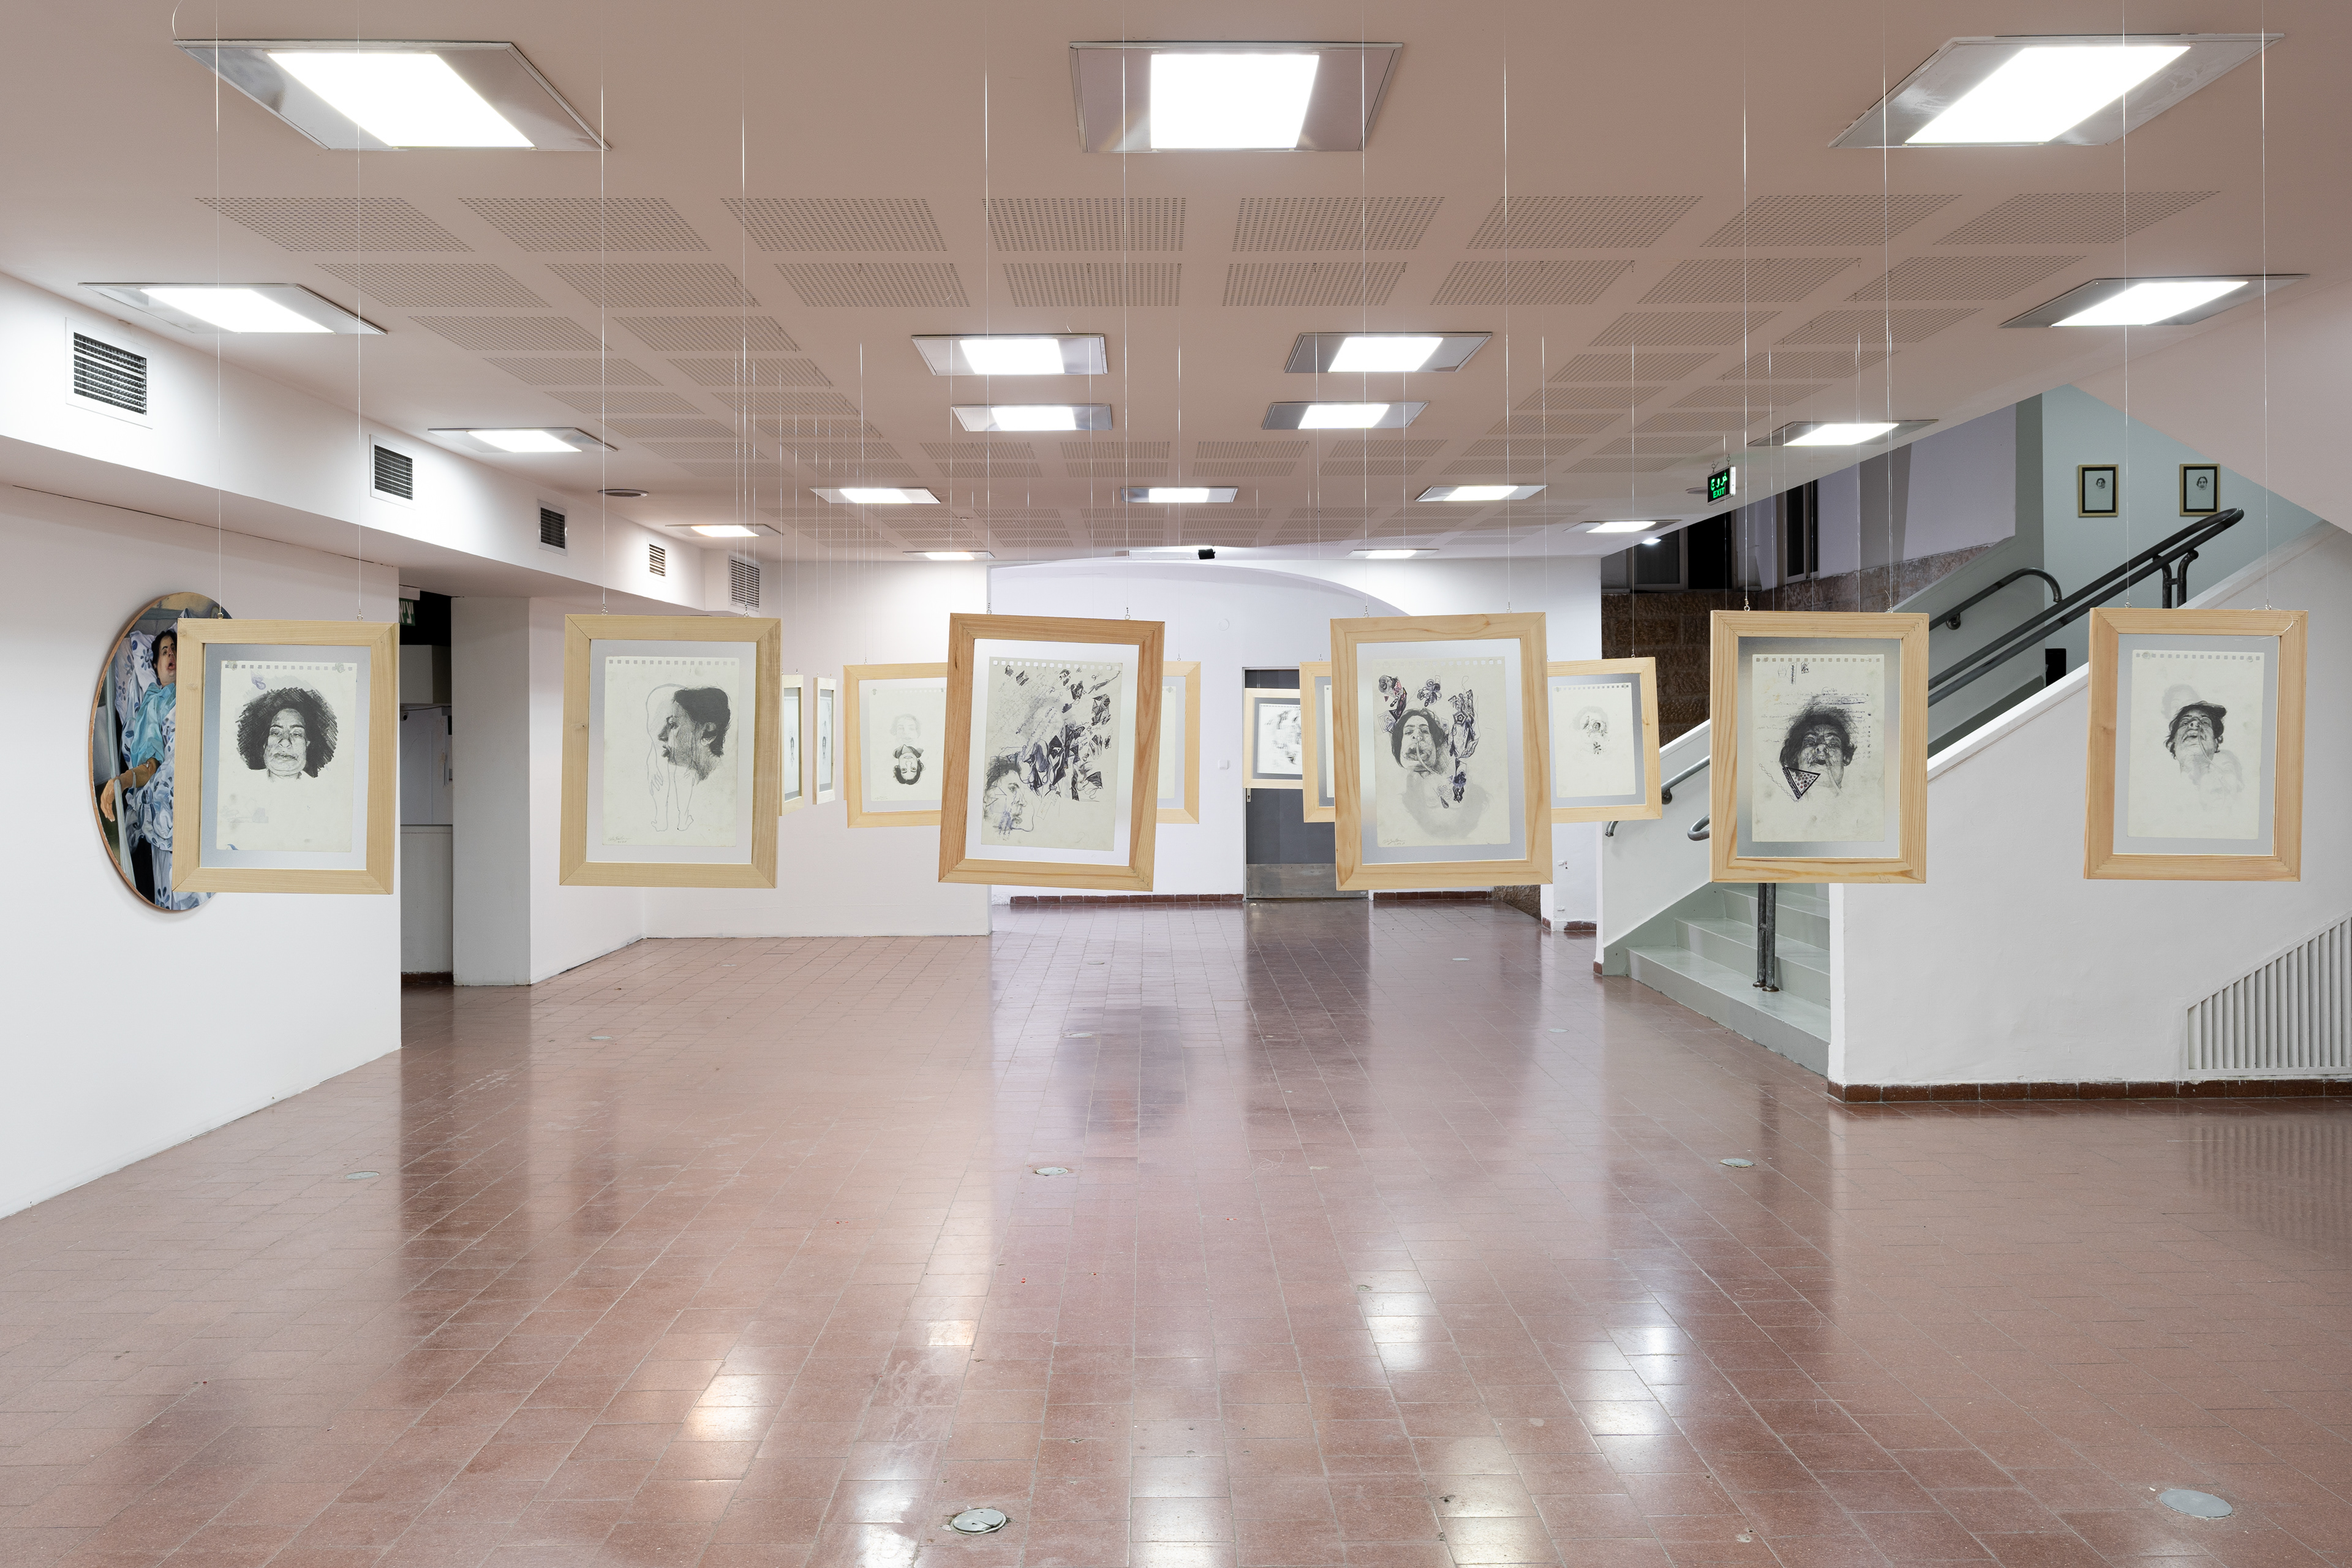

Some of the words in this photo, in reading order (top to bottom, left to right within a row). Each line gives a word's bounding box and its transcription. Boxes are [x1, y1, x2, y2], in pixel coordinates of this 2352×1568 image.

[1711, 472, 1727, 491] خروج
[1713, 487, 1725, 499] EXIT
[399, 600, 413, 624] יציא
